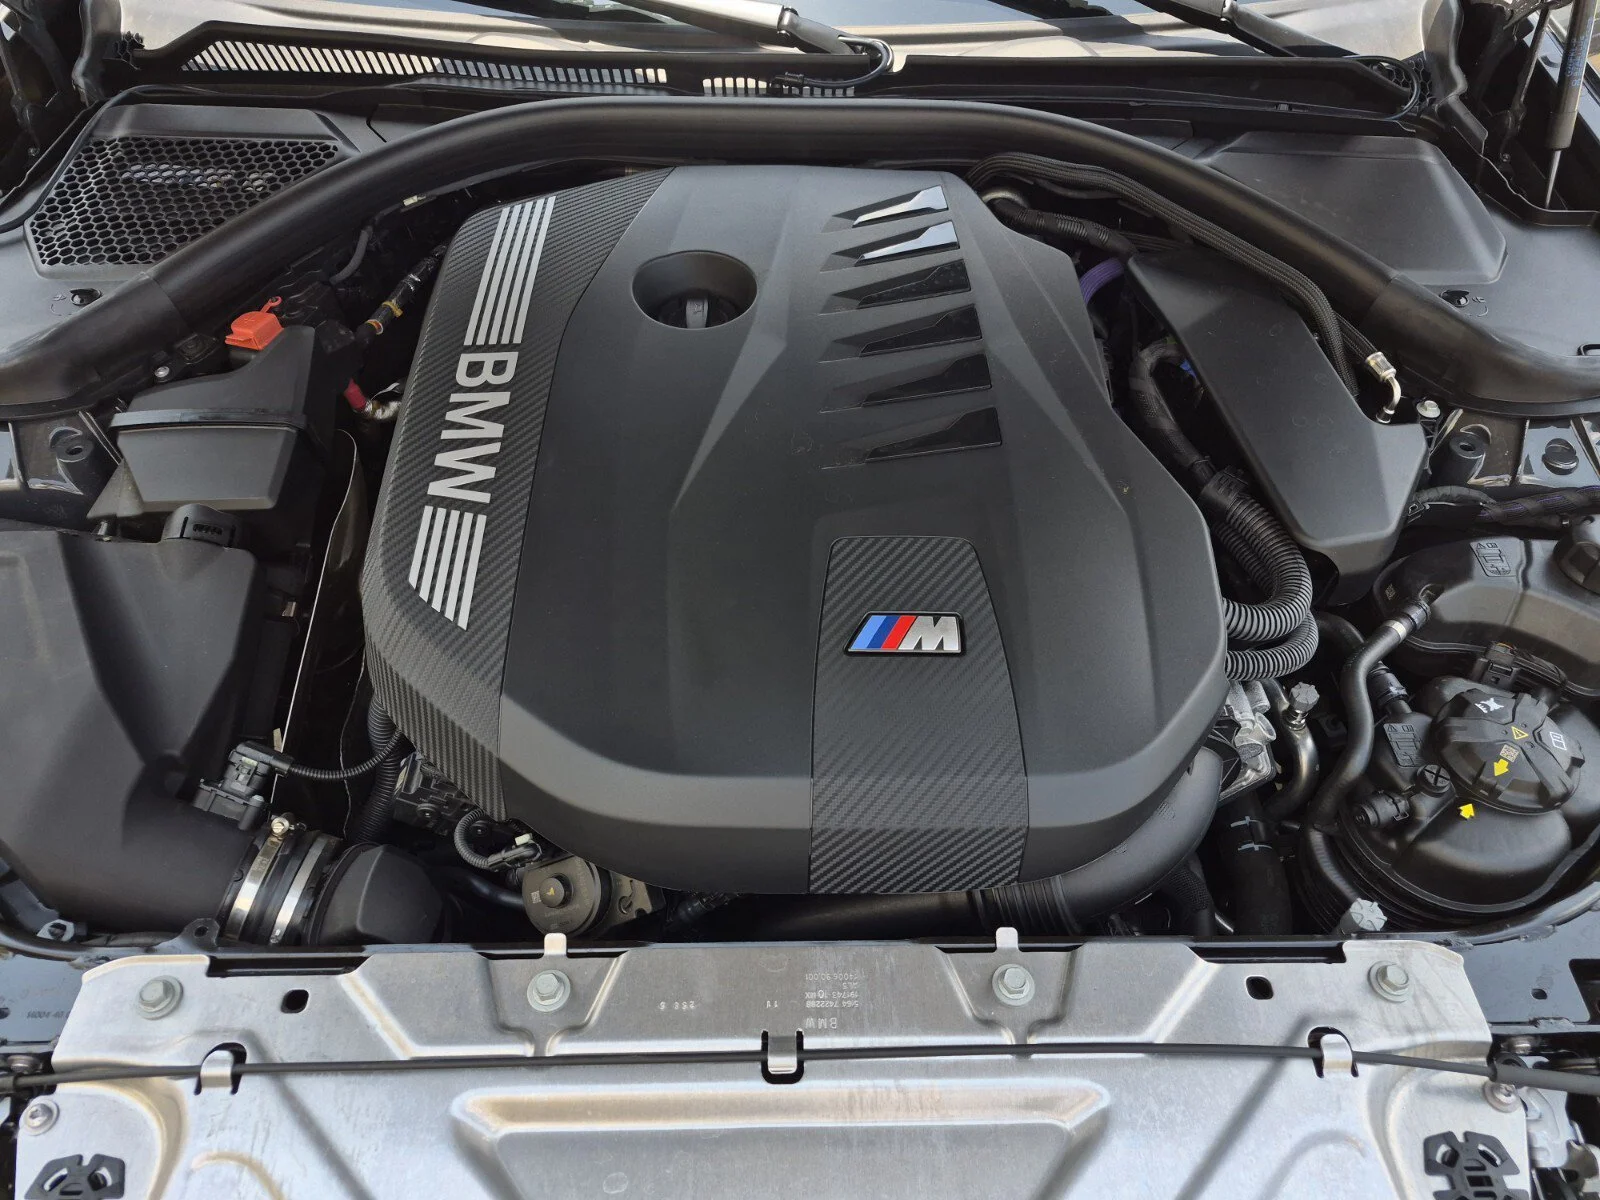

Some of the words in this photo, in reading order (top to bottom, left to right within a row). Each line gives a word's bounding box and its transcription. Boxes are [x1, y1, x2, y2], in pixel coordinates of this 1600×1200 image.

[427, 351, 519, 504] BMW
[898, 615, 959, 651] M
[805, 1017, 838, 1029] BMW
